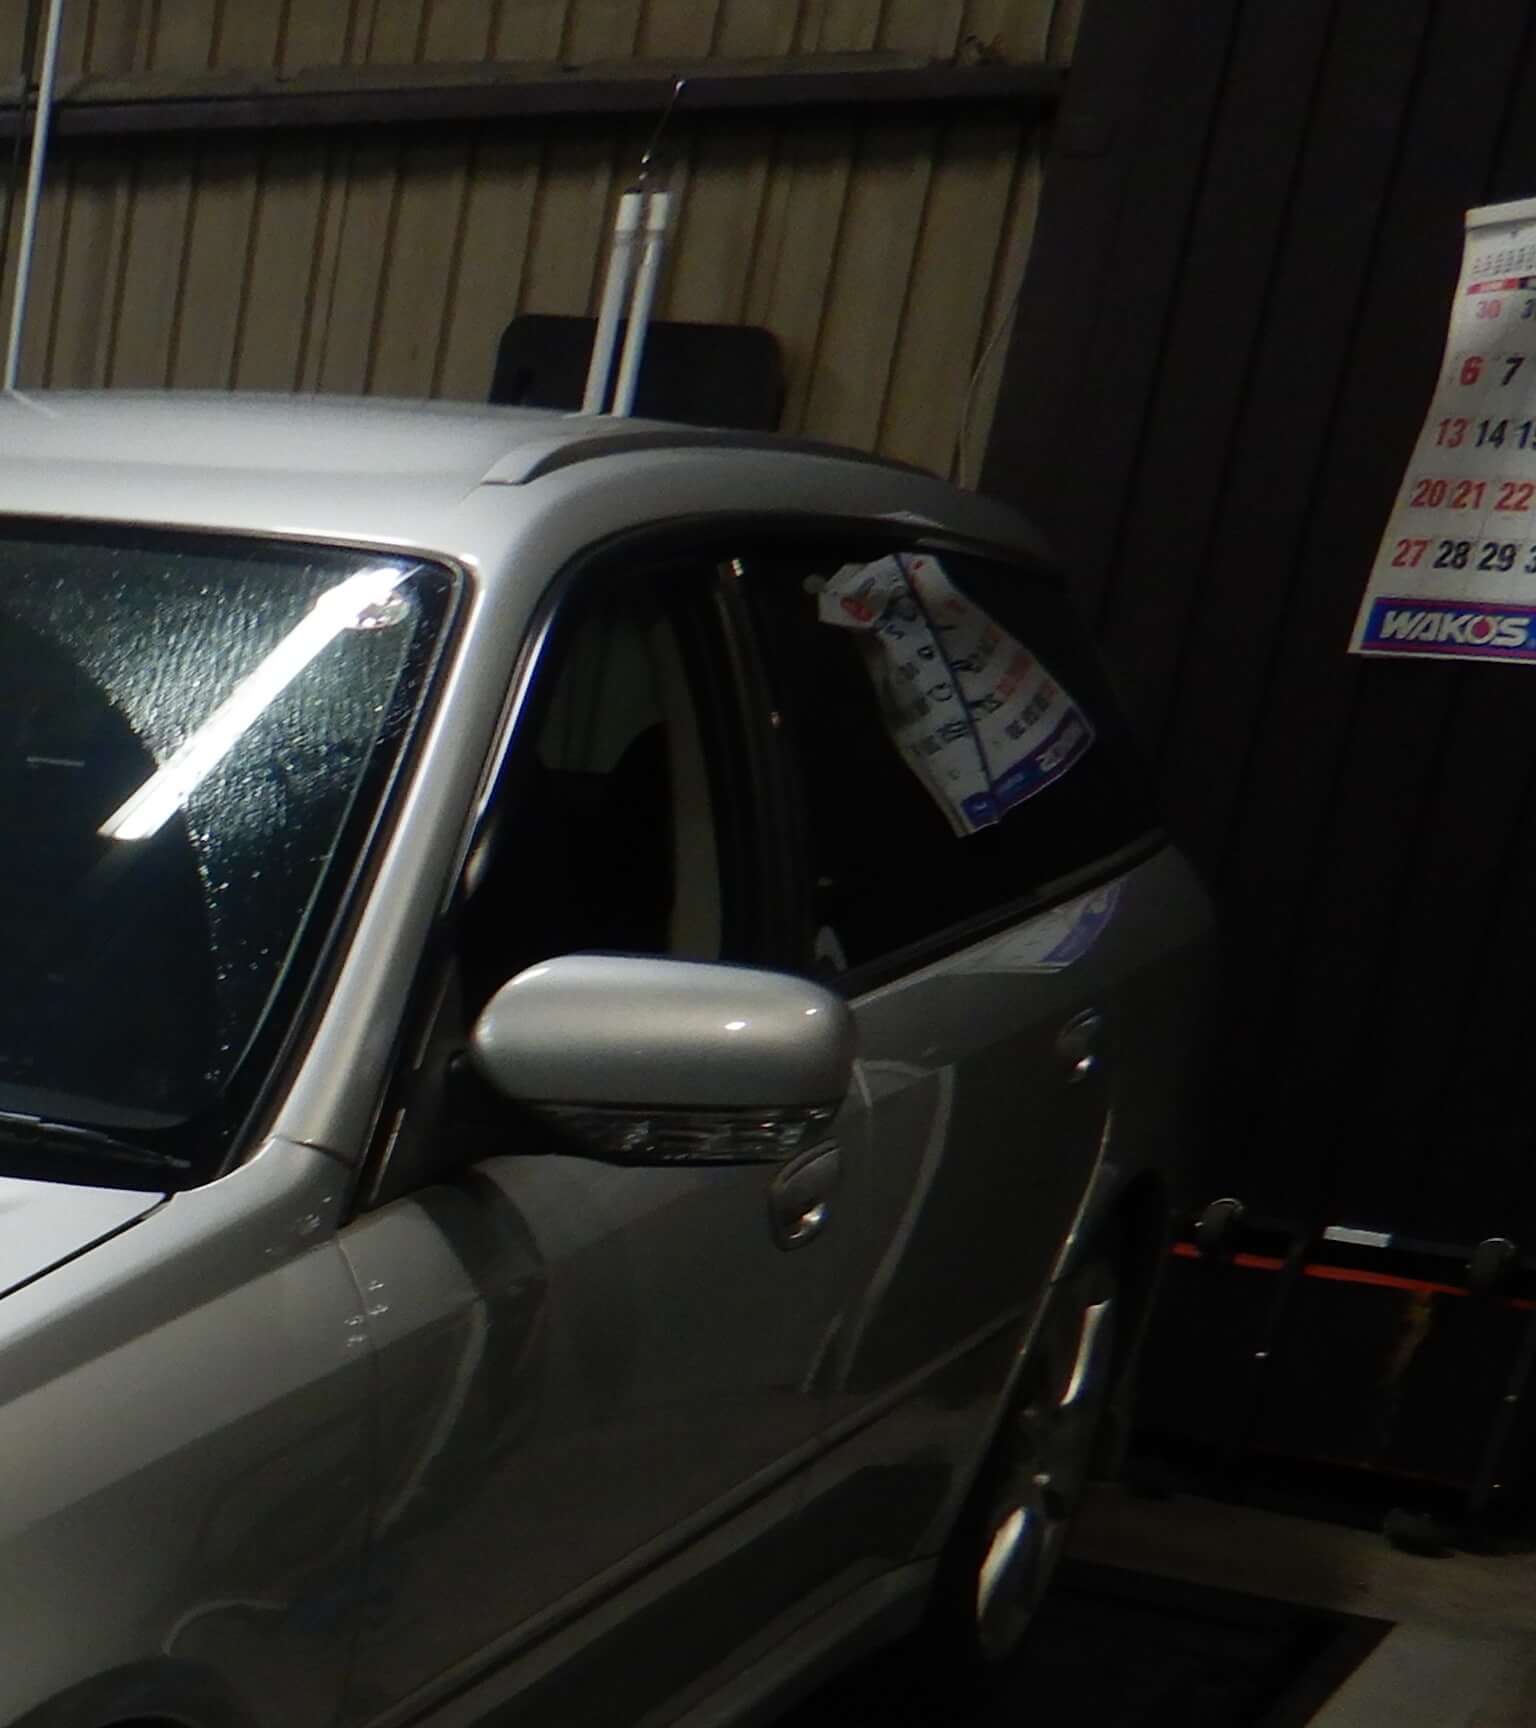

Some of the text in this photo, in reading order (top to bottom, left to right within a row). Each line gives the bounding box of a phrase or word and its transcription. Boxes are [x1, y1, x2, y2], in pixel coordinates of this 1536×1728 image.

[1460, 355, 1525, 386] 6 7
[1436, 417, 1468, 448] 13
[1475, 418, 1508, 449] 14
[1410, 478, 1535, 512] 20 21 22
[1391, 538, 1429, 568] 27
[1433, 539, 1472, 569] 28
[1478, 541, 1517, 573] 29
